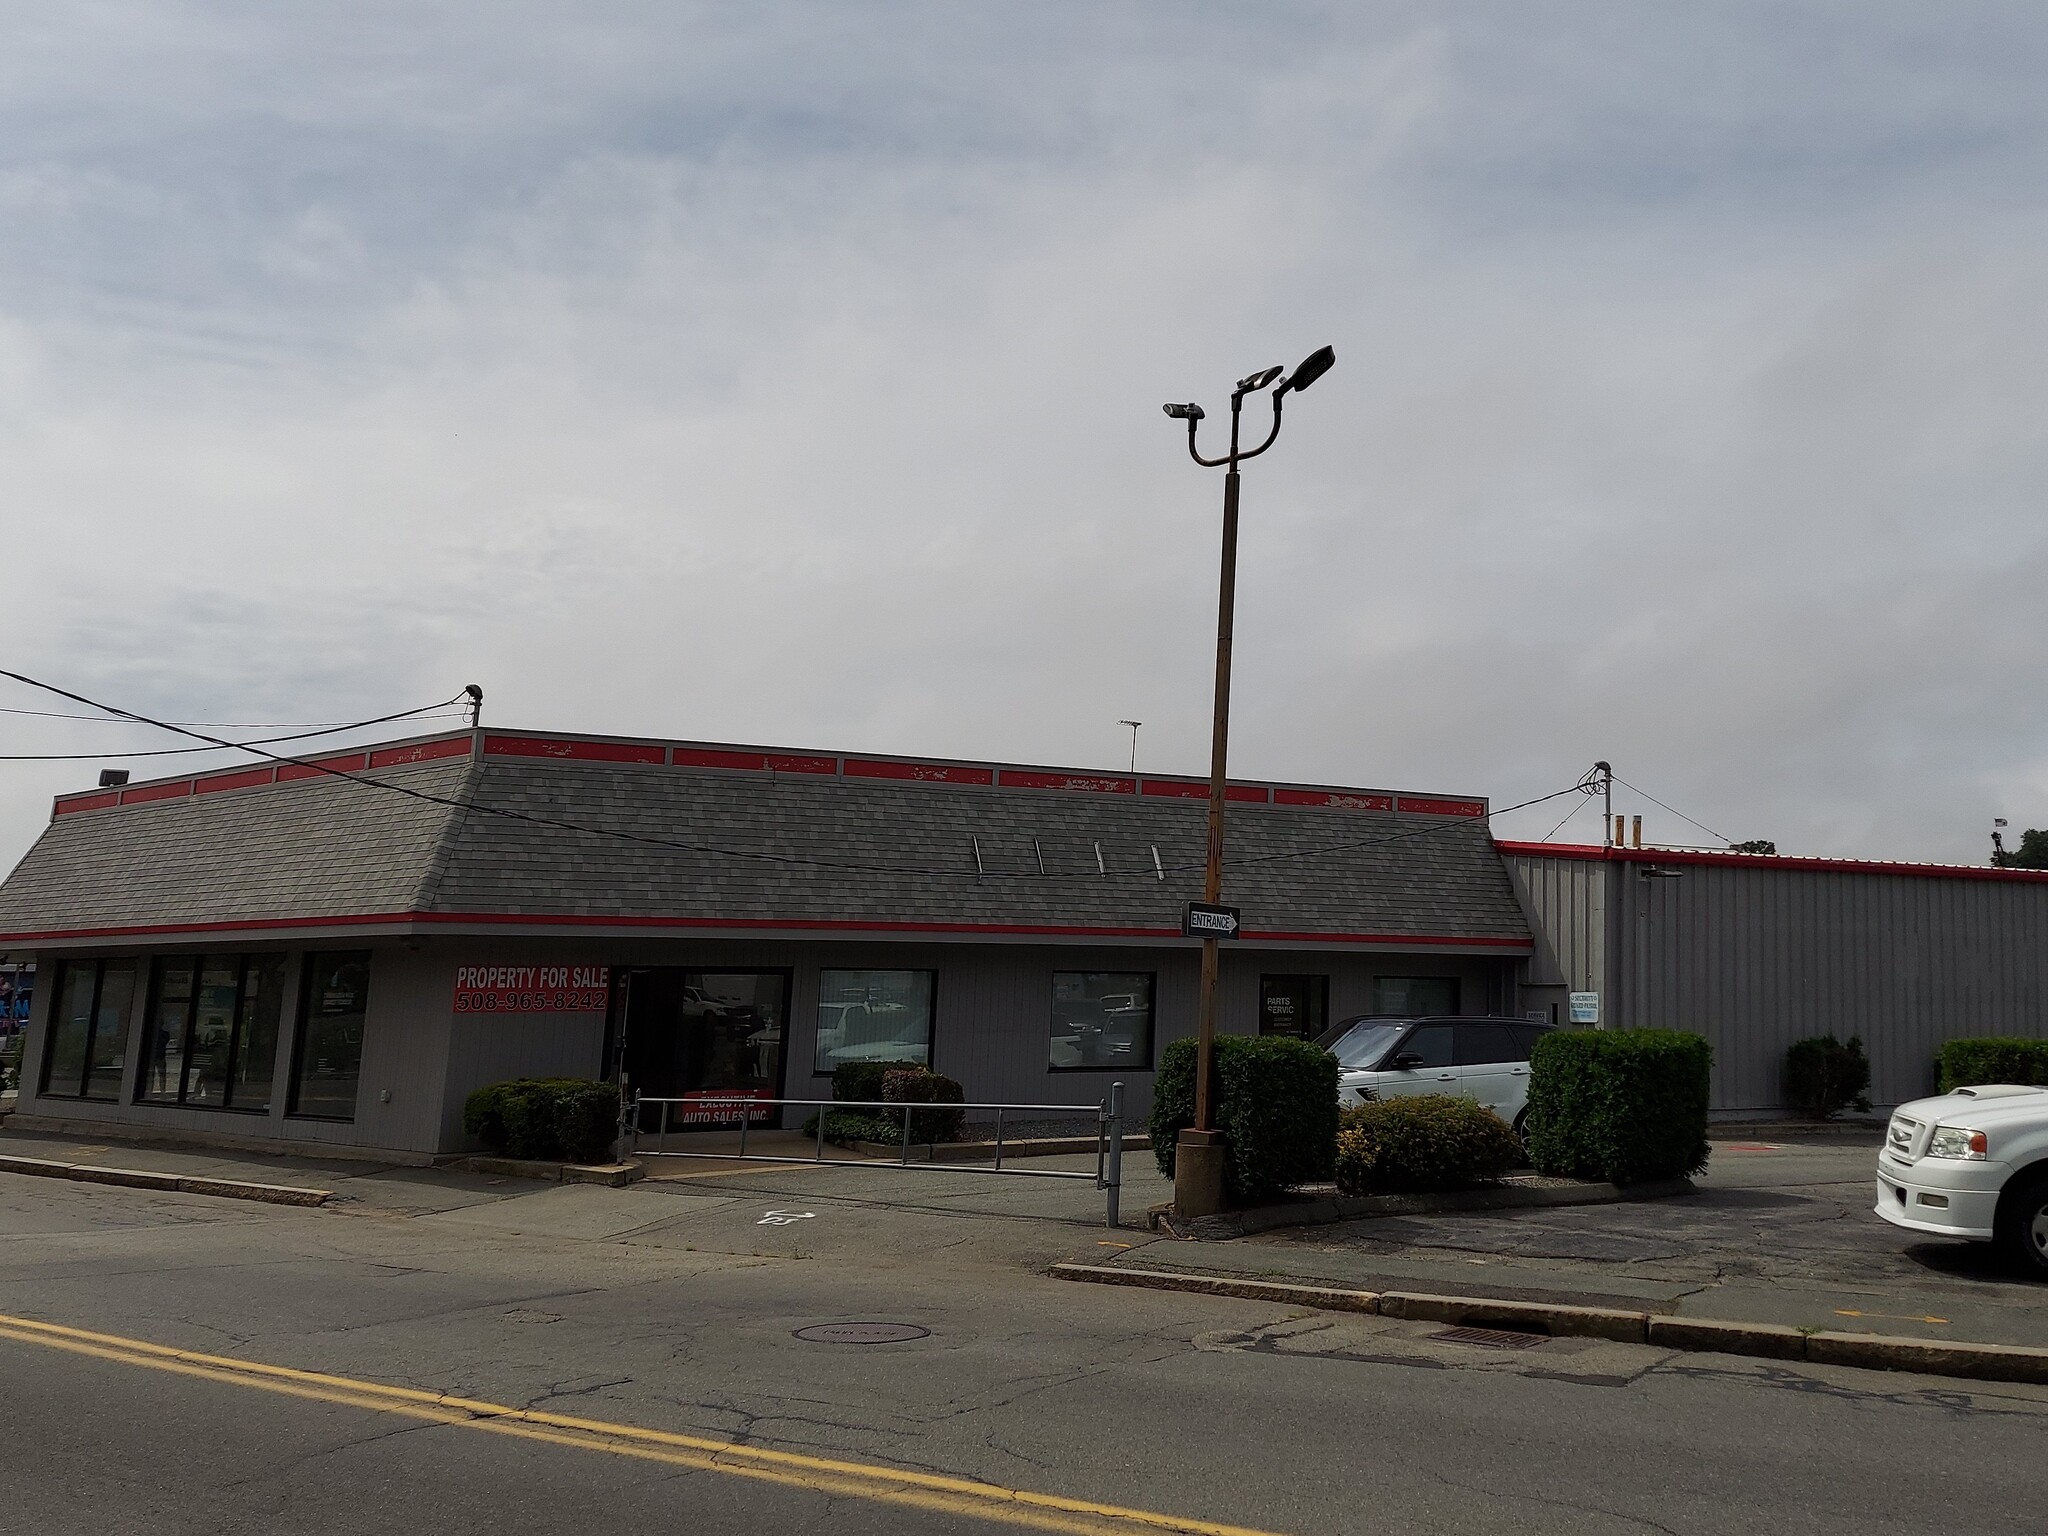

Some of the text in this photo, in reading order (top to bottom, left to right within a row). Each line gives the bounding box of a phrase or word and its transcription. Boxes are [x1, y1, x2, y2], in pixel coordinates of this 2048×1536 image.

[1191, 912, 1230, 929] ENTRANCE
[456, 967, 609, 989] PROPERTY FOR SALE
[455, 991, 606, 1011] 508-965-8242
[1267, 997, 1291, 1006] PARTS
[683, 1109, 769, 1123] AUTO SALES INC.
